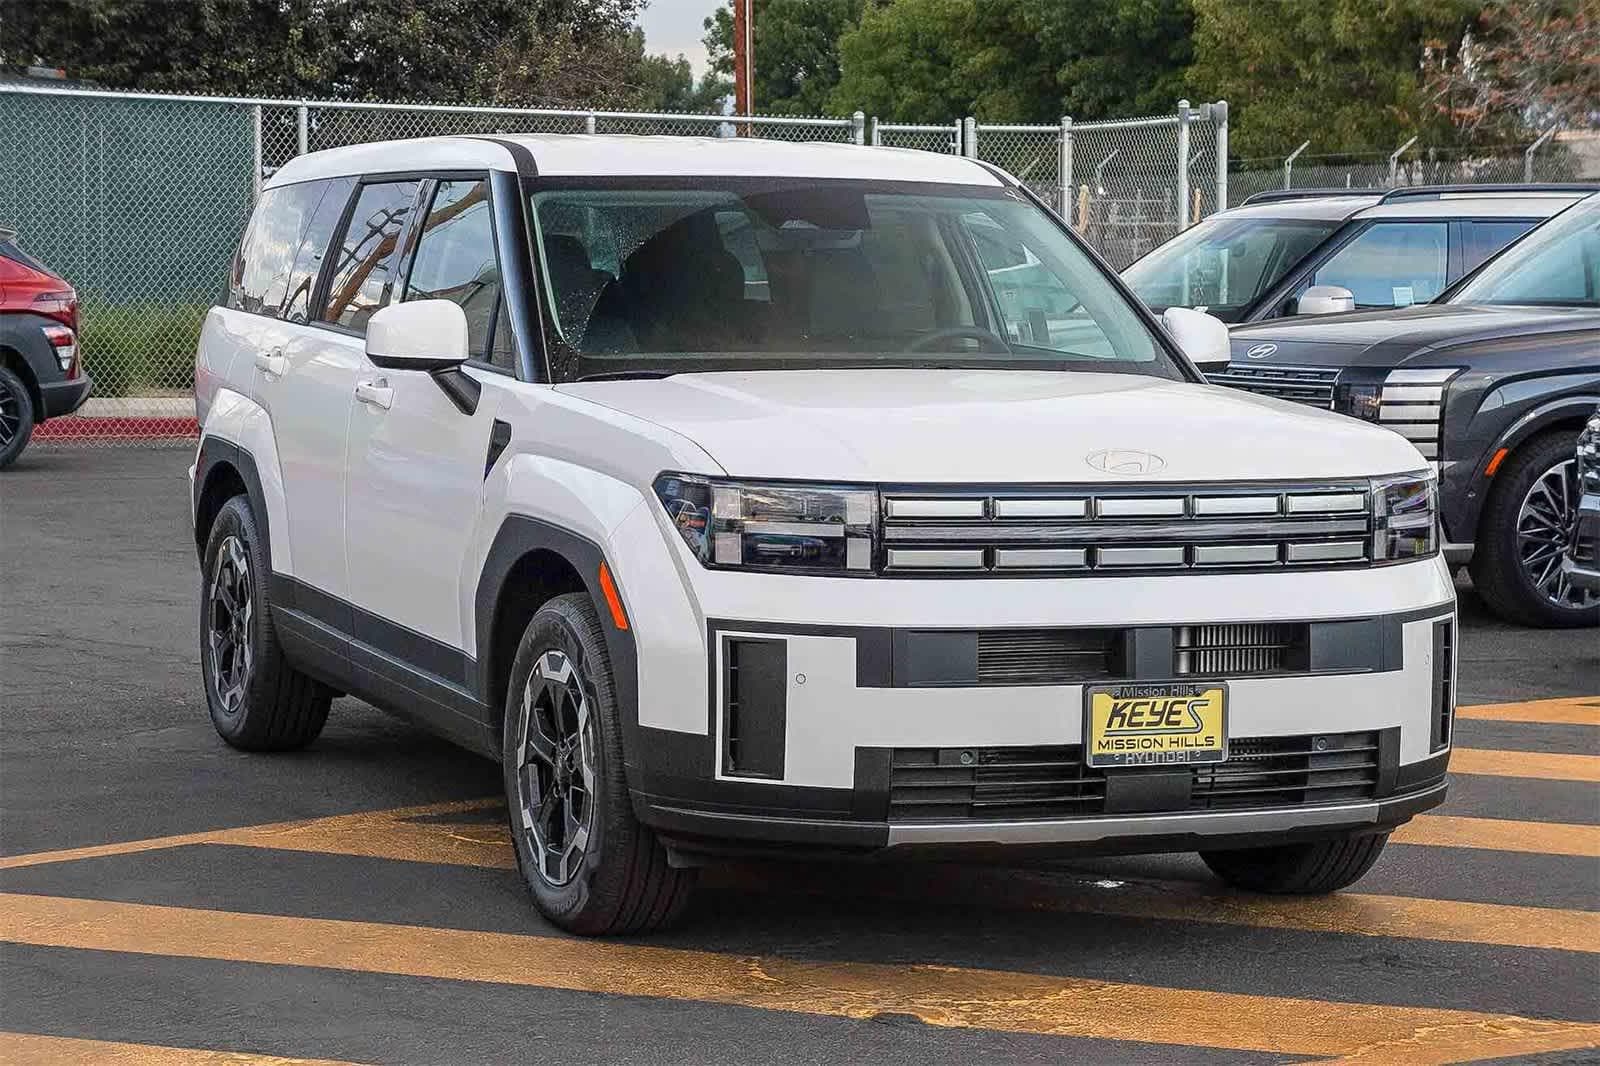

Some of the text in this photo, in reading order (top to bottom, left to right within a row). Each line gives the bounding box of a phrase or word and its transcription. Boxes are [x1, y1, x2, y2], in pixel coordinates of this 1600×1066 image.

[1121, 685, 1194, 698] Mission Hills
[1104, 699, 1210, 736] KEYES
[1098, 736, 1215, 751] MISSION HILLS
